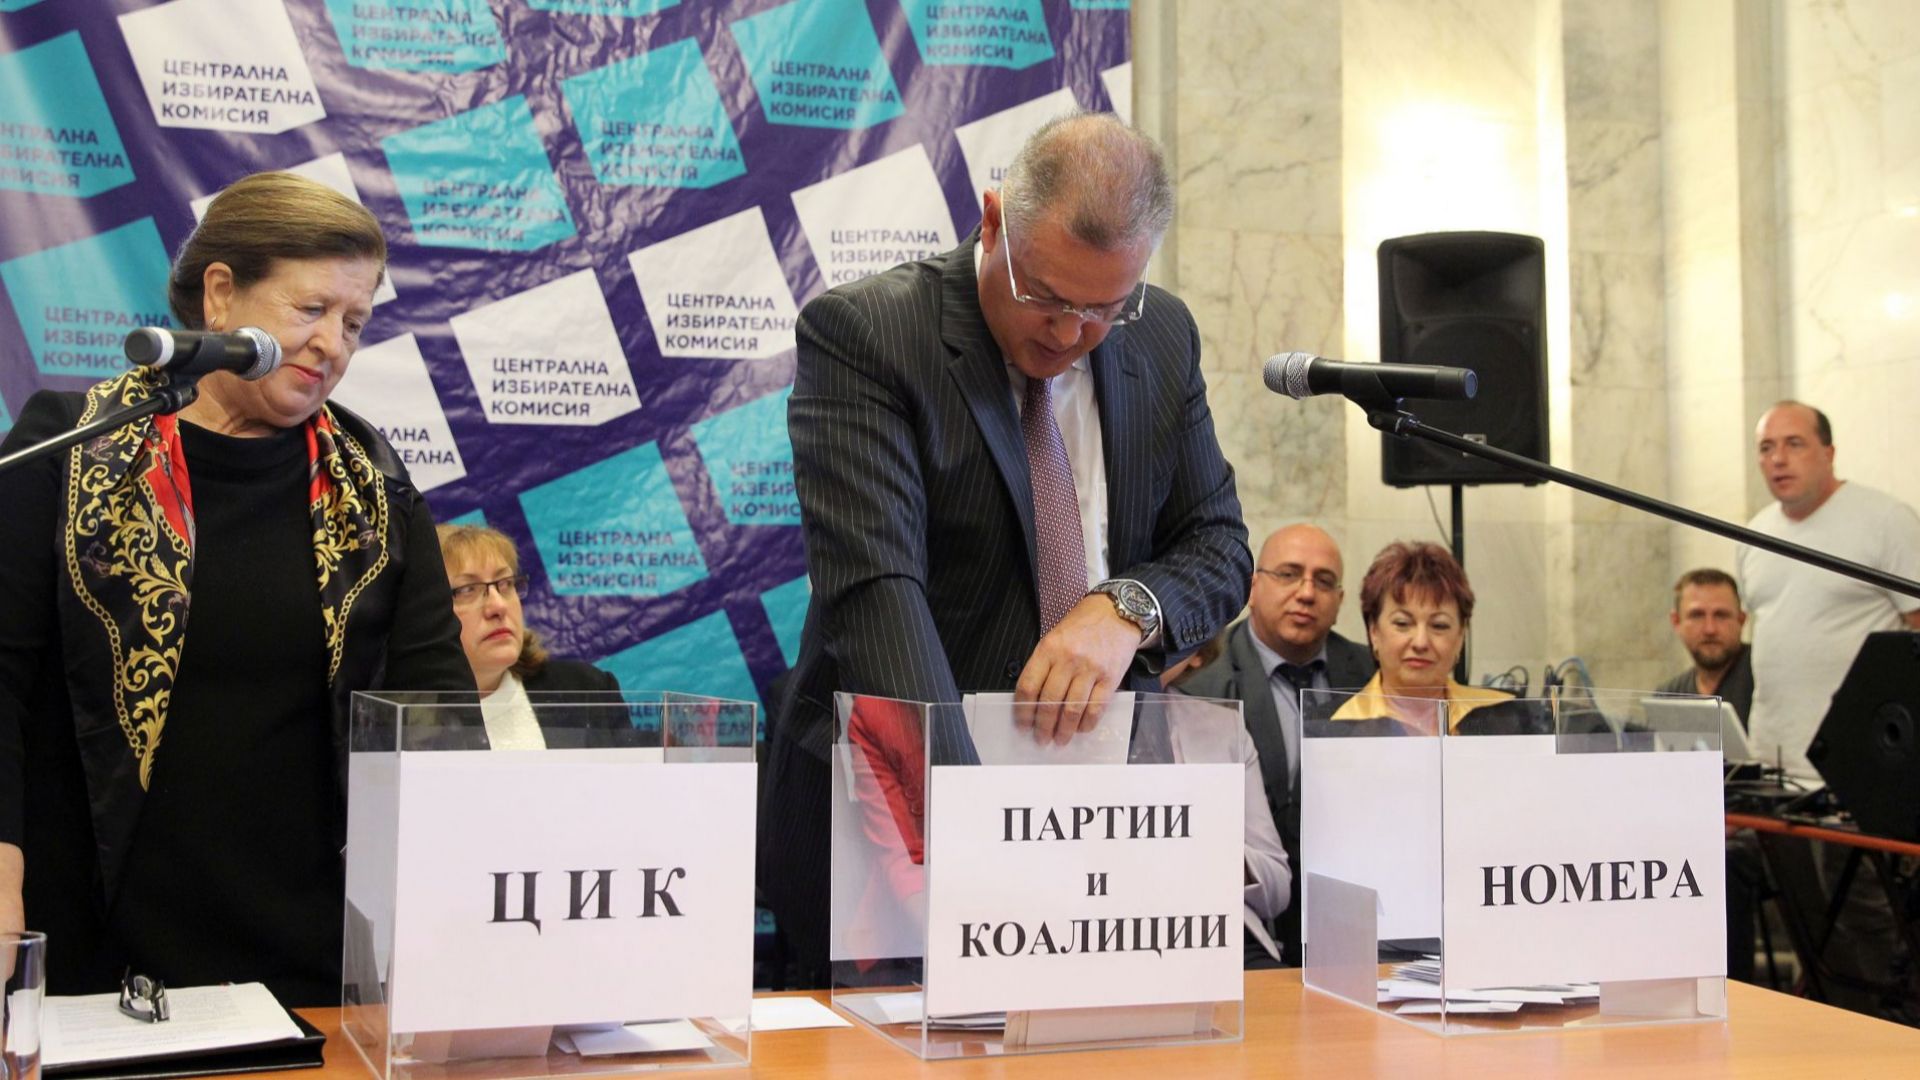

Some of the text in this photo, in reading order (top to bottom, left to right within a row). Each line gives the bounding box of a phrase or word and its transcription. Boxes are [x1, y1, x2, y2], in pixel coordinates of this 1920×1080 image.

[926, 5, 1029, 22] ЦЕНТРАЛНА
[926, 24, 1046, 46] ИЗБИРАТЕЛНА
[163, 60, 289, 82] ЦЕНТРАЛНА
[771, 62, 871, 82] ЦЕНТРАЛНА
[162, 81, 316, 105] ИЗБИРАТЕЛНА
[771, 81, 896, 103] ИЗБИРАТЕЛНА
[161, 102, 270, 125] КОМИСИЯ
[770, 101, 856, 121] КОМИСИЯ
[831, 230, 940, 244] ЦЕНТРАЛНА
[667, 293, 775, 310] ЦЕНТРАЛНА
[45, 307, 172, 327] ЦЕНТРАЛНА
[666, 314, 797, 331] ИЗБИРАТЕЛНА
[665, 334, 758, 351] КОМИСИЯ
[493, 357, 609, 375] ЦЕНТРАЛНА
[492, 379, 632, 397] ИЗБИРАТЕЛНА
[491, 401, 591, 416] КОМИСИЯ
[558, 531, 673, 547] ЦЕНТРАЛНА
[557, 551, 699, 567] ИЗБИРАТЕЛНА
[557, 572, 657, 588] КОМИСИЯ
[1001, 804, 1192, 842] ПАРТИИ
[1480, 858, 1704, 907] НОМЕРА
[959, 914, 1230, 959] КОАЛИЦИИ
